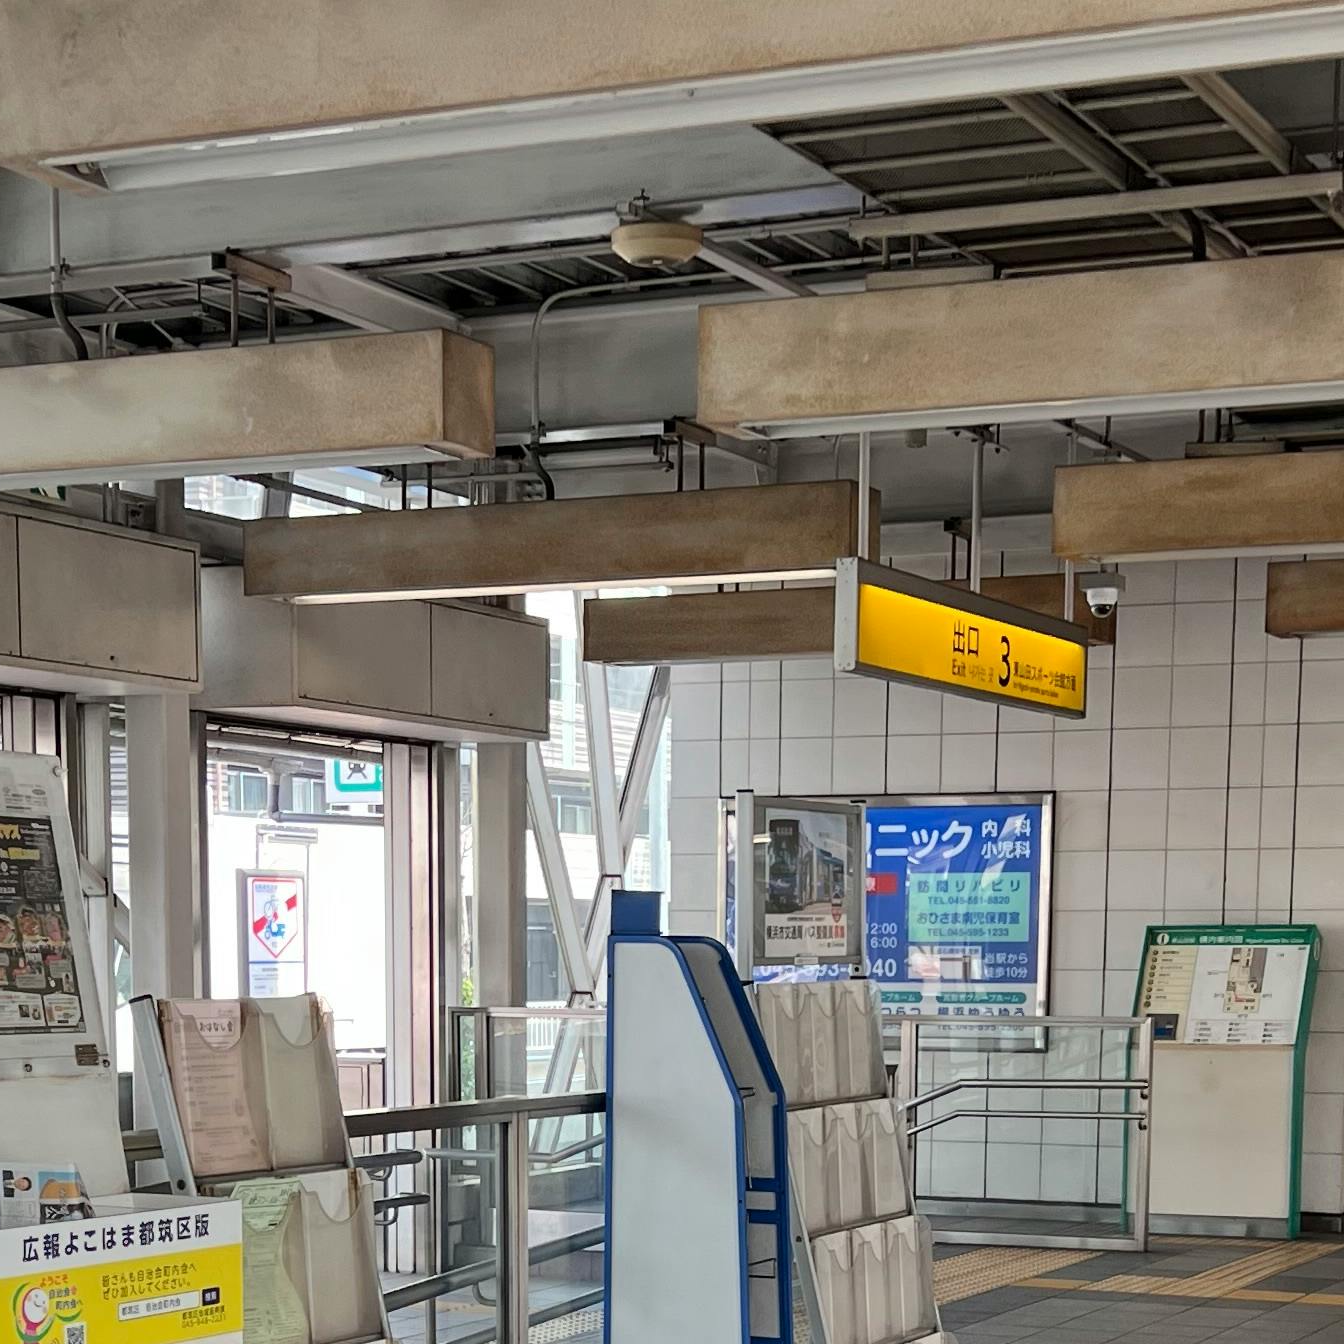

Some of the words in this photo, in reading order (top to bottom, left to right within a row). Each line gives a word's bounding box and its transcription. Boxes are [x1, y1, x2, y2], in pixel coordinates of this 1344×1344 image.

[952, 620, 979, 657] 出口
[952, 659, 966, 677] Exit
[999, 636, 1010, 687] 3
[981, 841, 1031, 859] 小児科
[199, 1019, 234, 1033] おはなし会
[22, 1213, 210, 1262] 広報よこはま都筑区版
[40, 1273, 69, 1287] ようこそ
[102, 1262, 197, 1287] 皆さんも自治会町内会へ
[103, 1278, 191, 1300] ぜひ加入してください。
